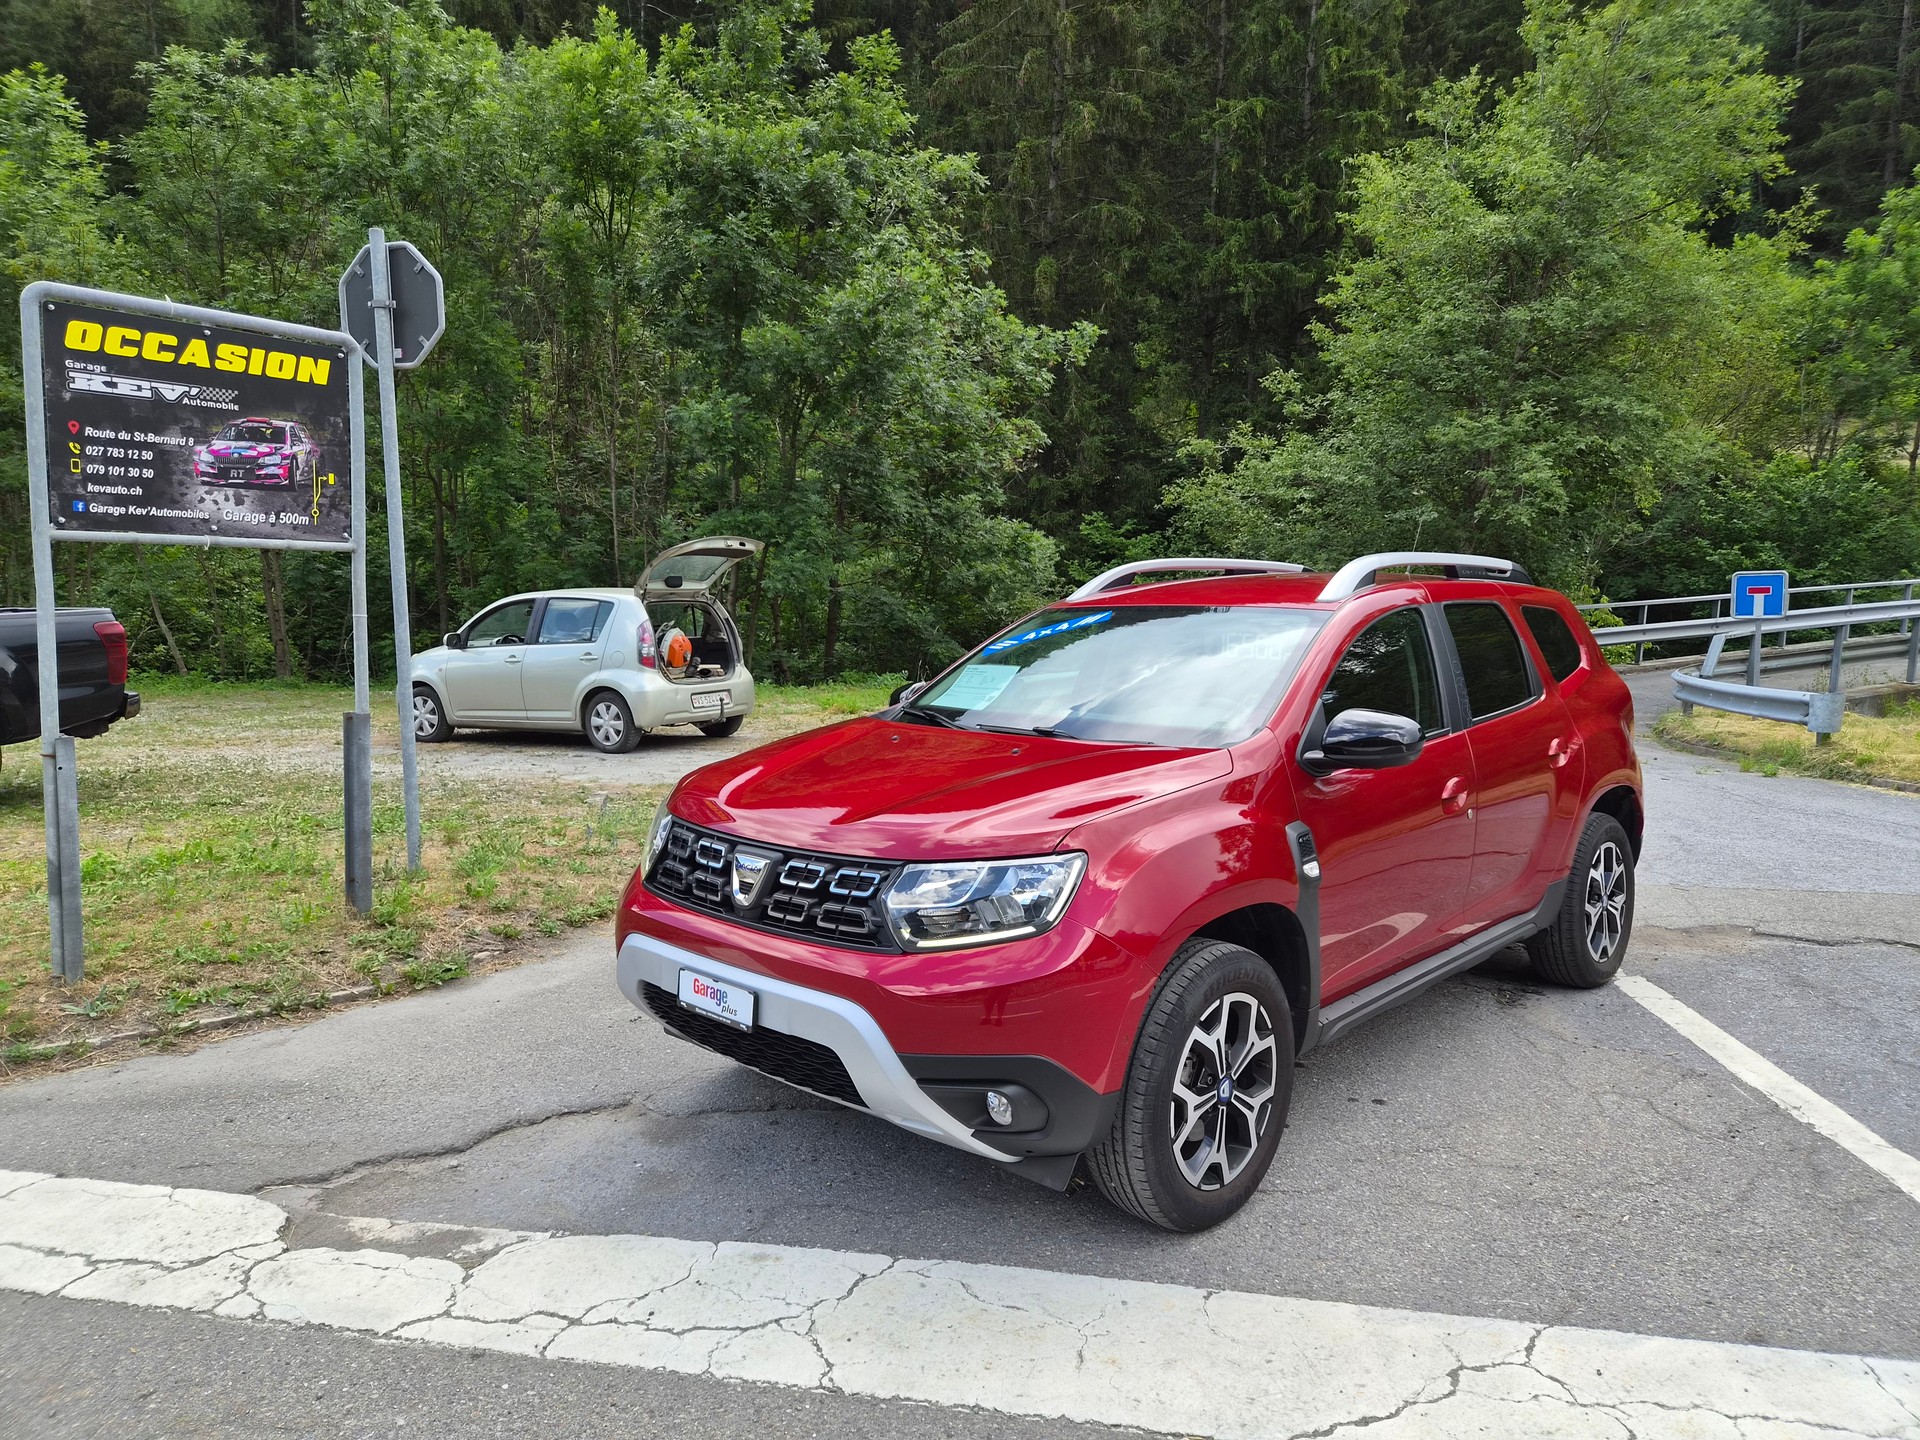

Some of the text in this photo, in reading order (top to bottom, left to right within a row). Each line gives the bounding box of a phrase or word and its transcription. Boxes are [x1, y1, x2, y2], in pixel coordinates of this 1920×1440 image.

[64, 320, 332, 386] OCCASION
[65, 359, 107, 373] Garage
[182, 397, 239, 411] Automobile
[84, 426, 195, 447] Route du St-Bernard 8
[85, 445, 154, 461] 027 783 12 50
[86, 464, 155, 479] 079 101 30 50
[230, 469, 245, 478] RT
[87, 482, 143, 496] kevauto.ch
[89, 502, 126, 517] Garage
[223, 509, 309, 525] Garage à 500m
[1022, 622, 1070, 641] 4x4
[693, 977, 728, 1007] Garage
[721, 1004, 738, 1017] plus
